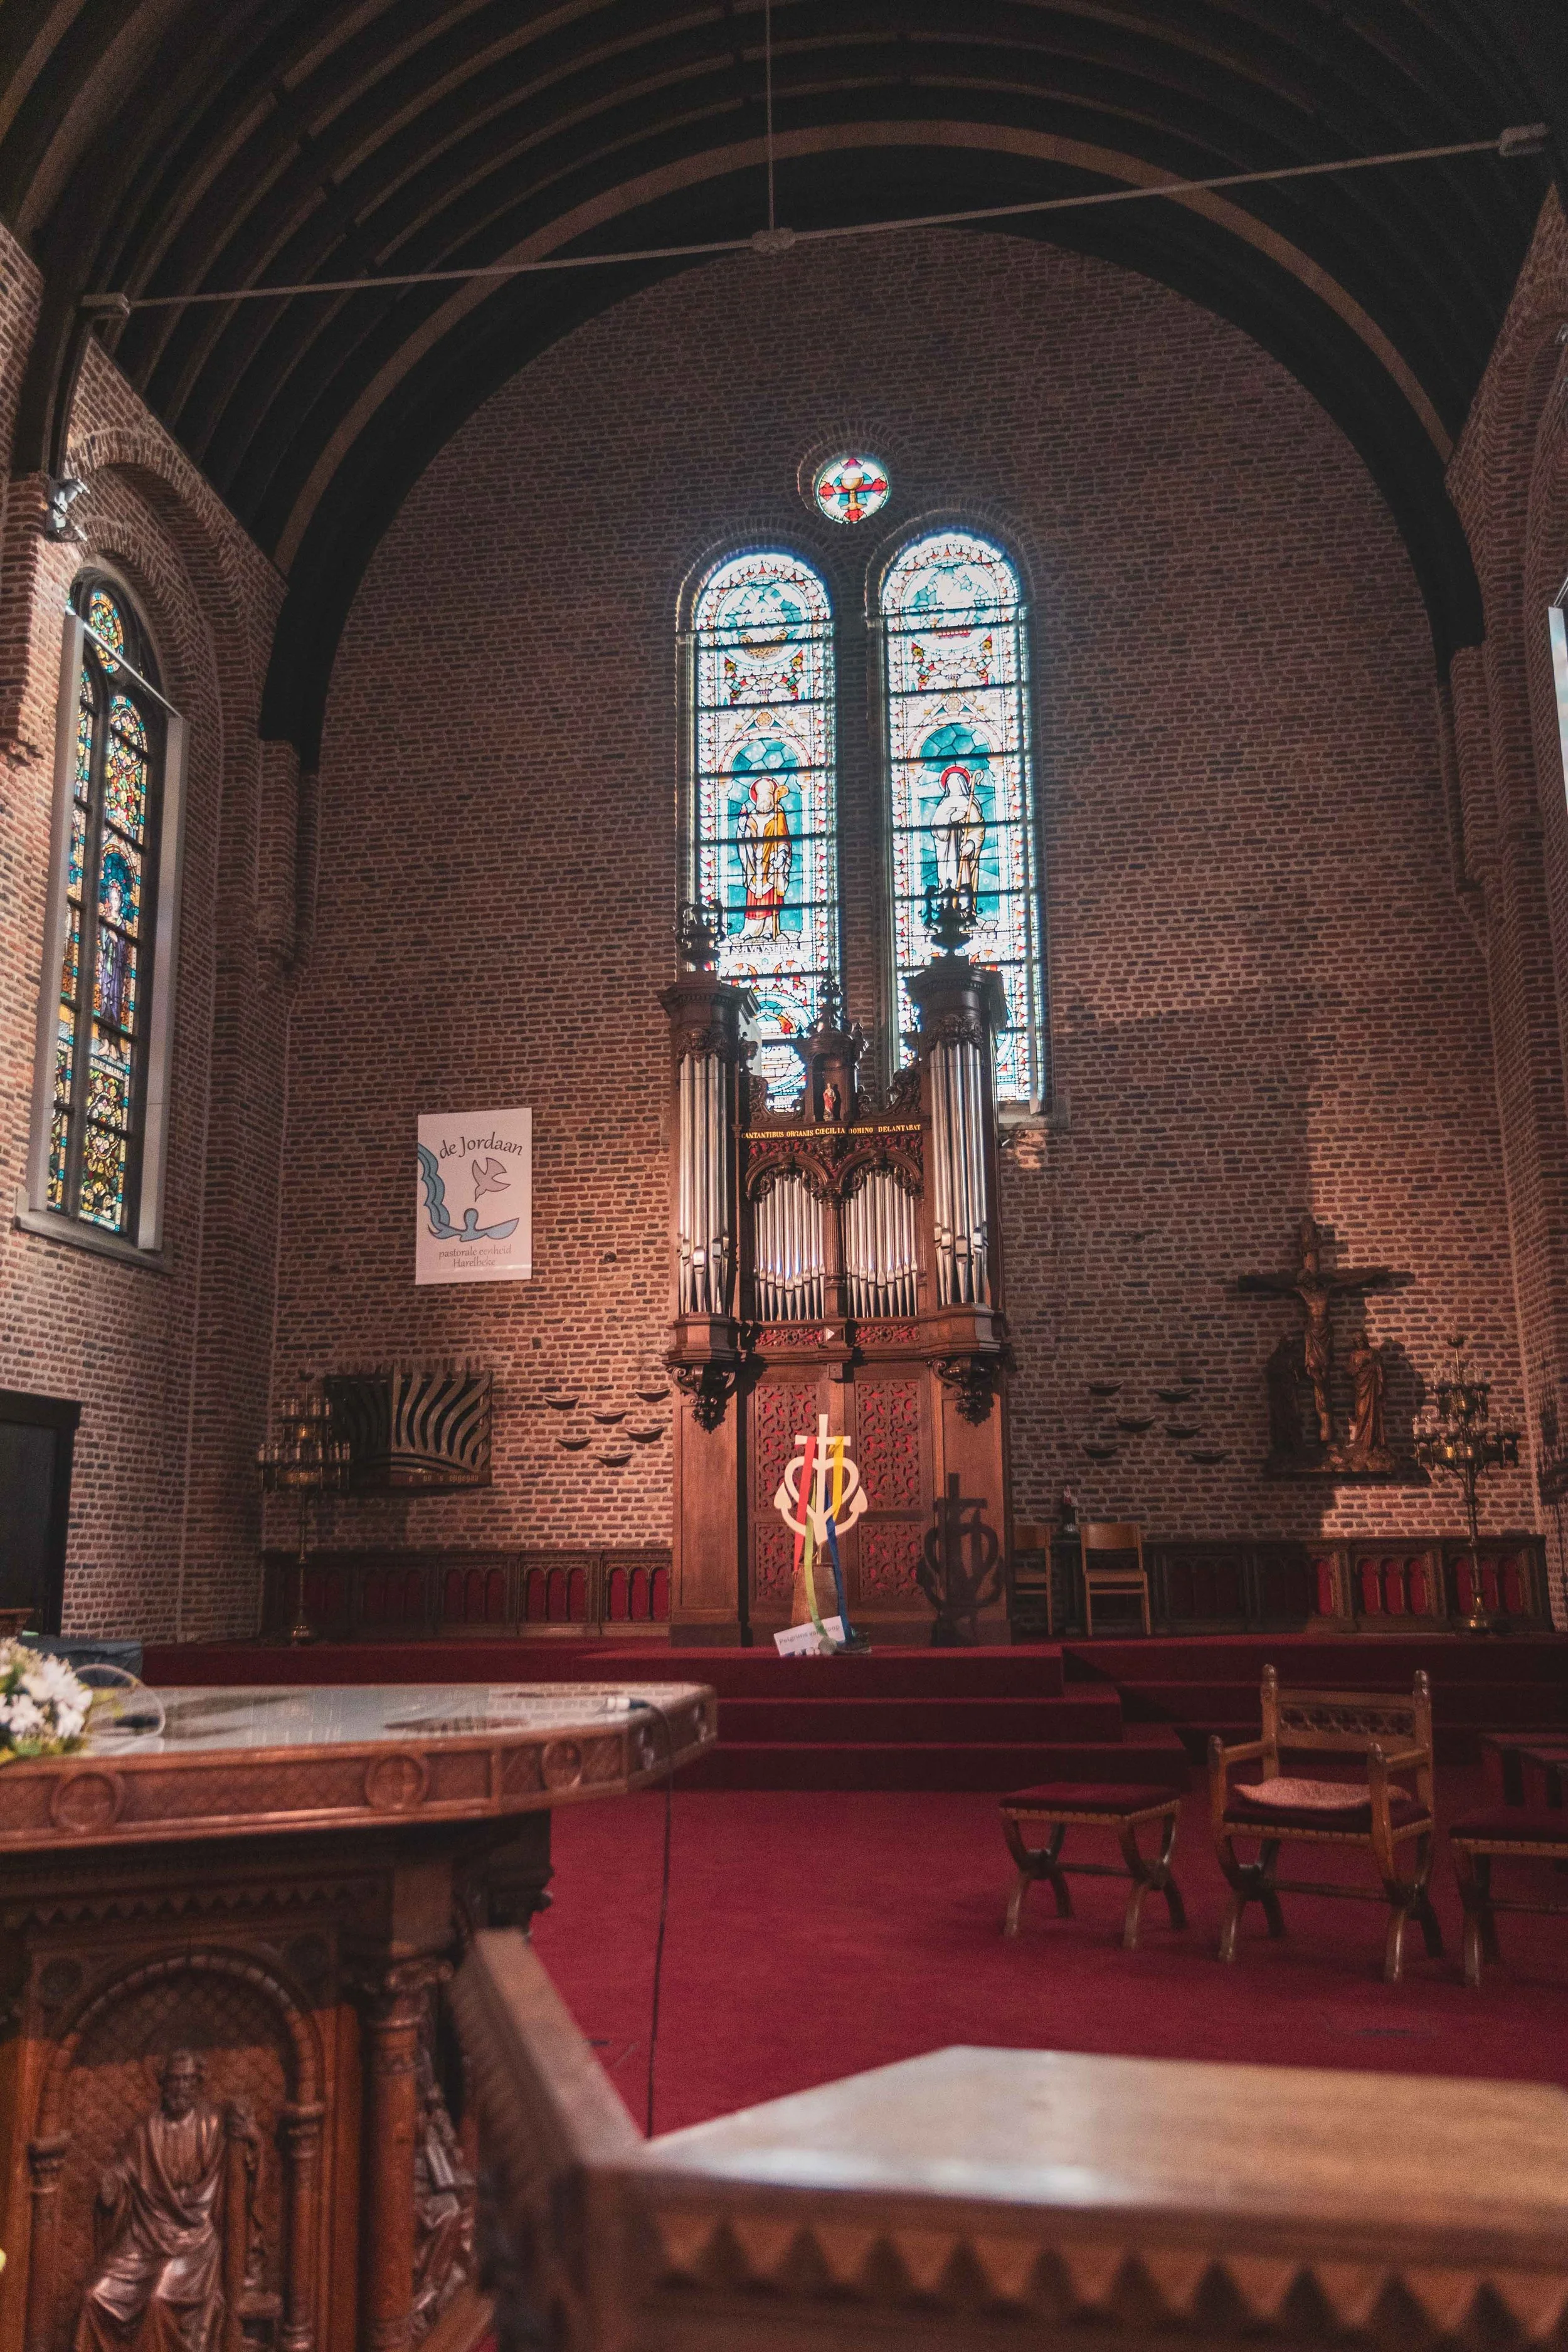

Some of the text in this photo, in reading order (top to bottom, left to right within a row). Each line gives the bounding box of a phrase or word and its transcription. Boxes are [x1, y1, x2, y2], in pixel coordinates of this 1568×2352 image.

[440, 1131, 522, 1158] de Jordaan
[438, 1244, 511, 1260] pastorale eenheid
[453, 1256, 495, 1267] Harelbeke
